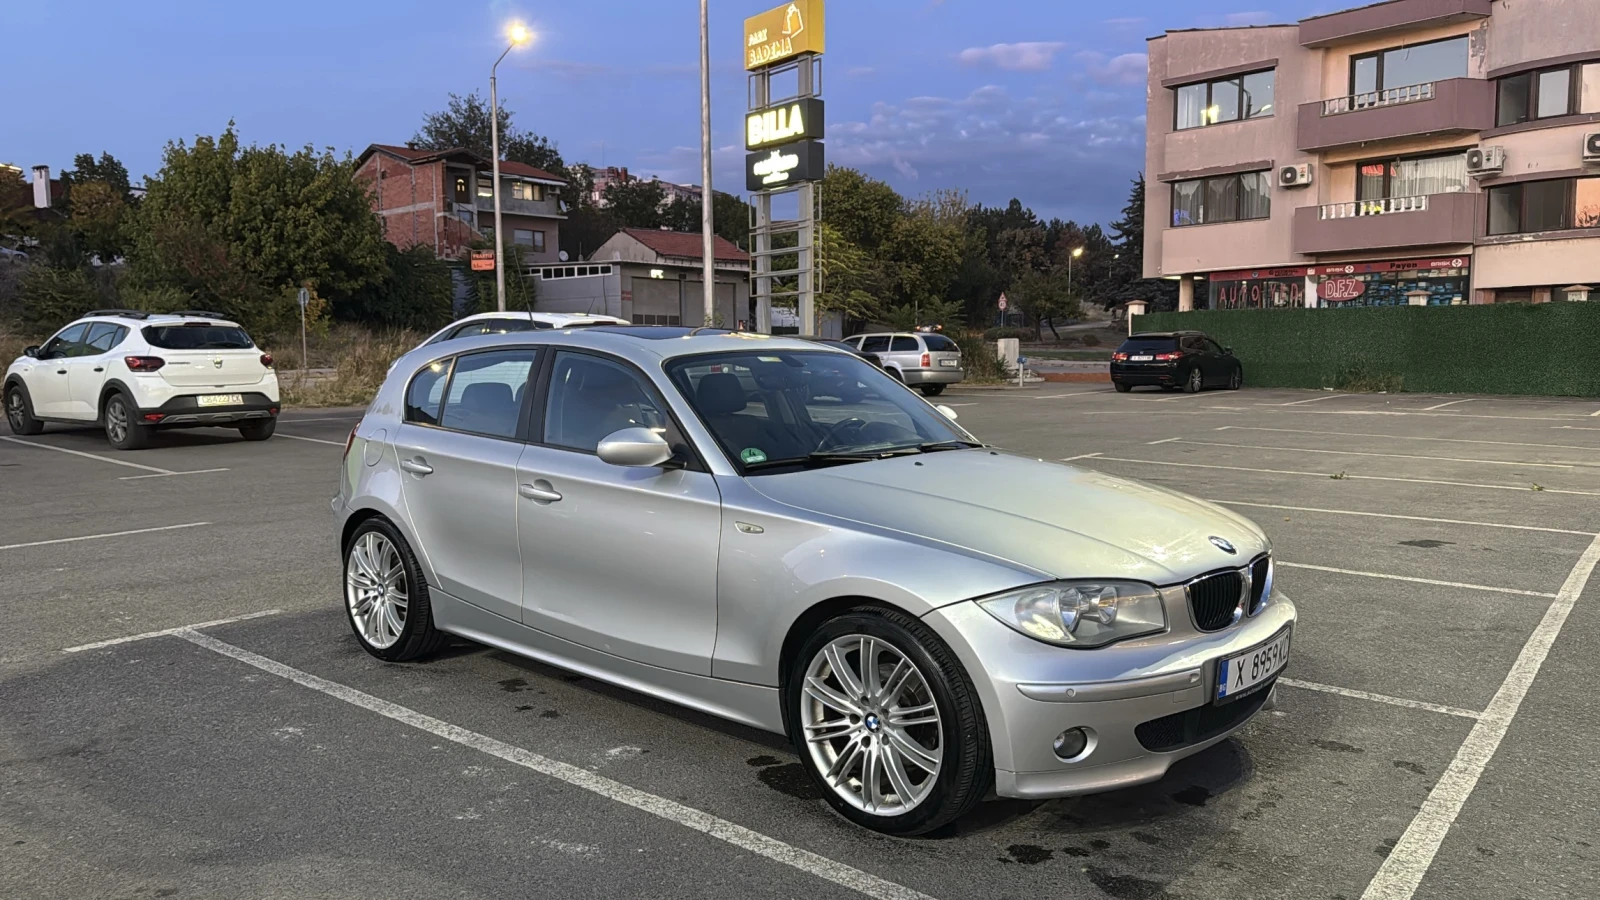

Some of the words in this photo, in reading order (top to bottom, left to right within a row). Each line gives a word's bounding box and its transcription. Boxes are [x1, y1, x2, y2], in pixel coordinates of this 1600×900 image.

[748, 36, 793, 67] BADEMA
[747, 104, 804, 146] BILLA
[1390, 262, 1417, 270] Payen
[1234, 659, 1246, 688] X
[1251, 643, 1278, 680] 8959
